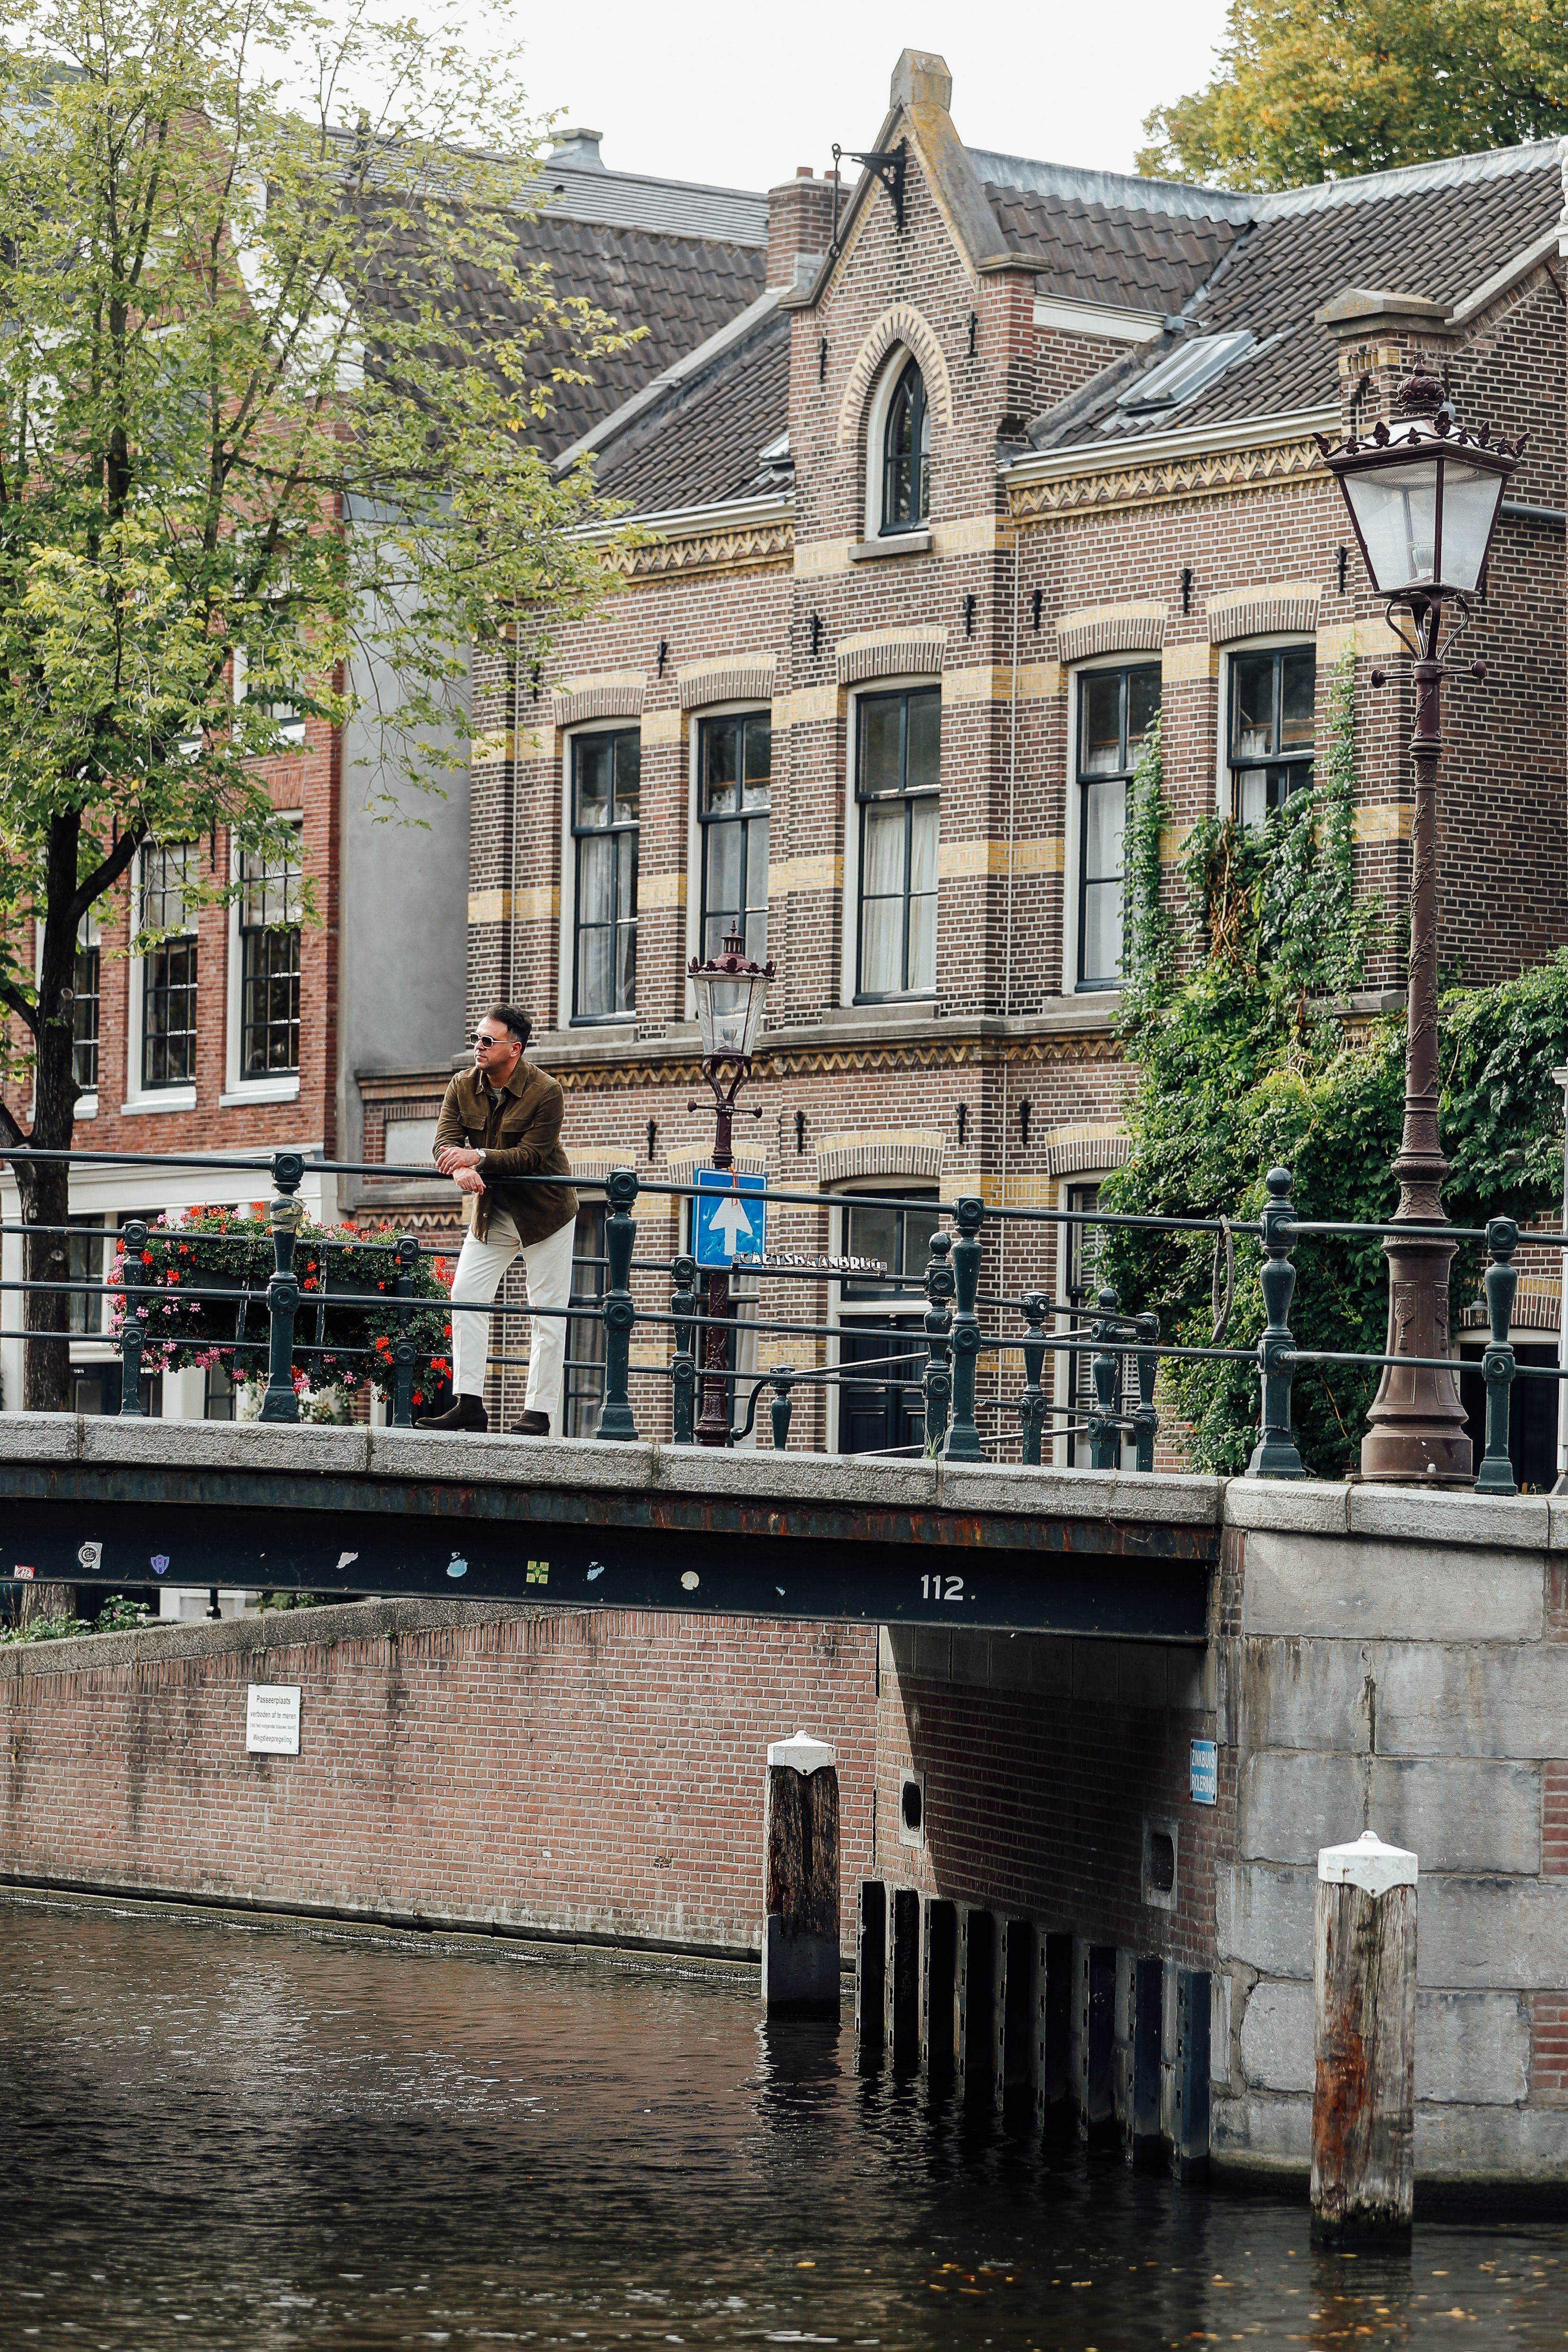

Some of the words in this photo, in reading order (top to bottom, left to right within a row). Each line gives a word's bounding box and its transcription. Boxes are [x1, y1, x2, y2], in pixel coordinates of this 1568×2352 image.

[921, 1574, 963, 1601] 112
[257, 1695, 291, 1705] Passeerplaats
[253, 1733, 292, 1745] Wegsleepregeling
[1192, 1750, 1215, 1769] ZINKBUIS
